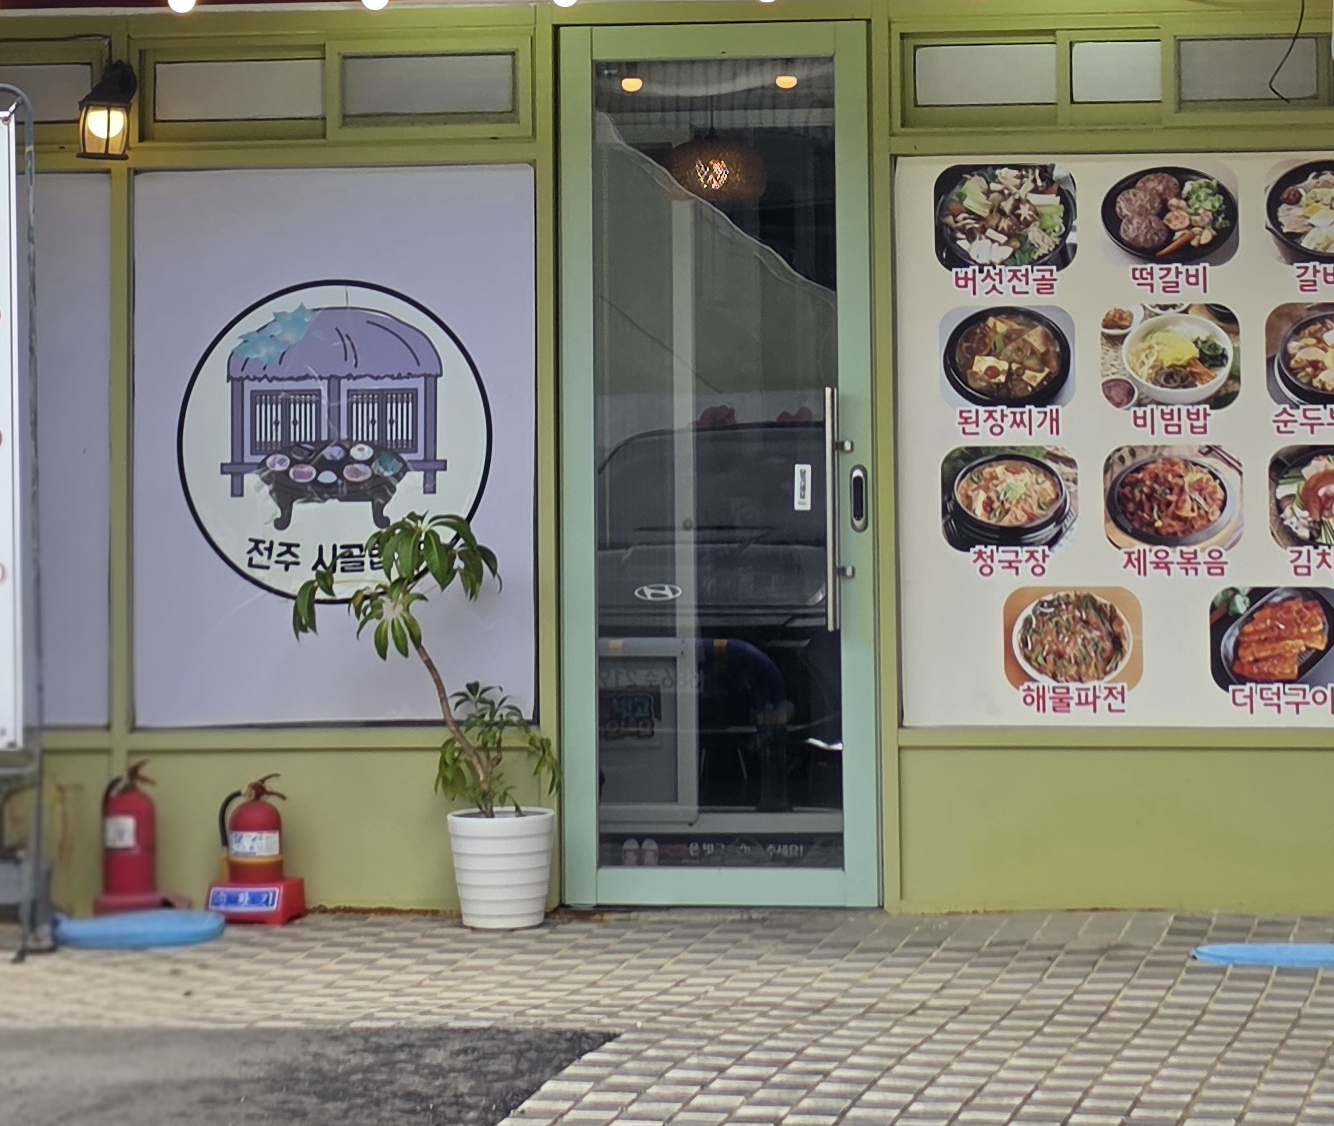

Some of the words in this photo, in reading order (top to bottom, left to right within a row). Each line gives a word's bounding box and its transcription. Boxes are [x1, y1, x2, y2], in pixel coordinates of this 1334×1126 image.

[953, 268, 1058, 296] 버섯전골
[1131, 267, 1208, 294] 떡갈비
[957, 409, 1061, 436] 된장찌개
[1133, 408, 1211, 435] 비빔밥
[246, 537, 301, 573] 전주
[972, 548, 1050, 577] 청국장
[1123, 548, 1229, 577] 제육볶음
[1022, 685, 1127, 714] 해물파전
